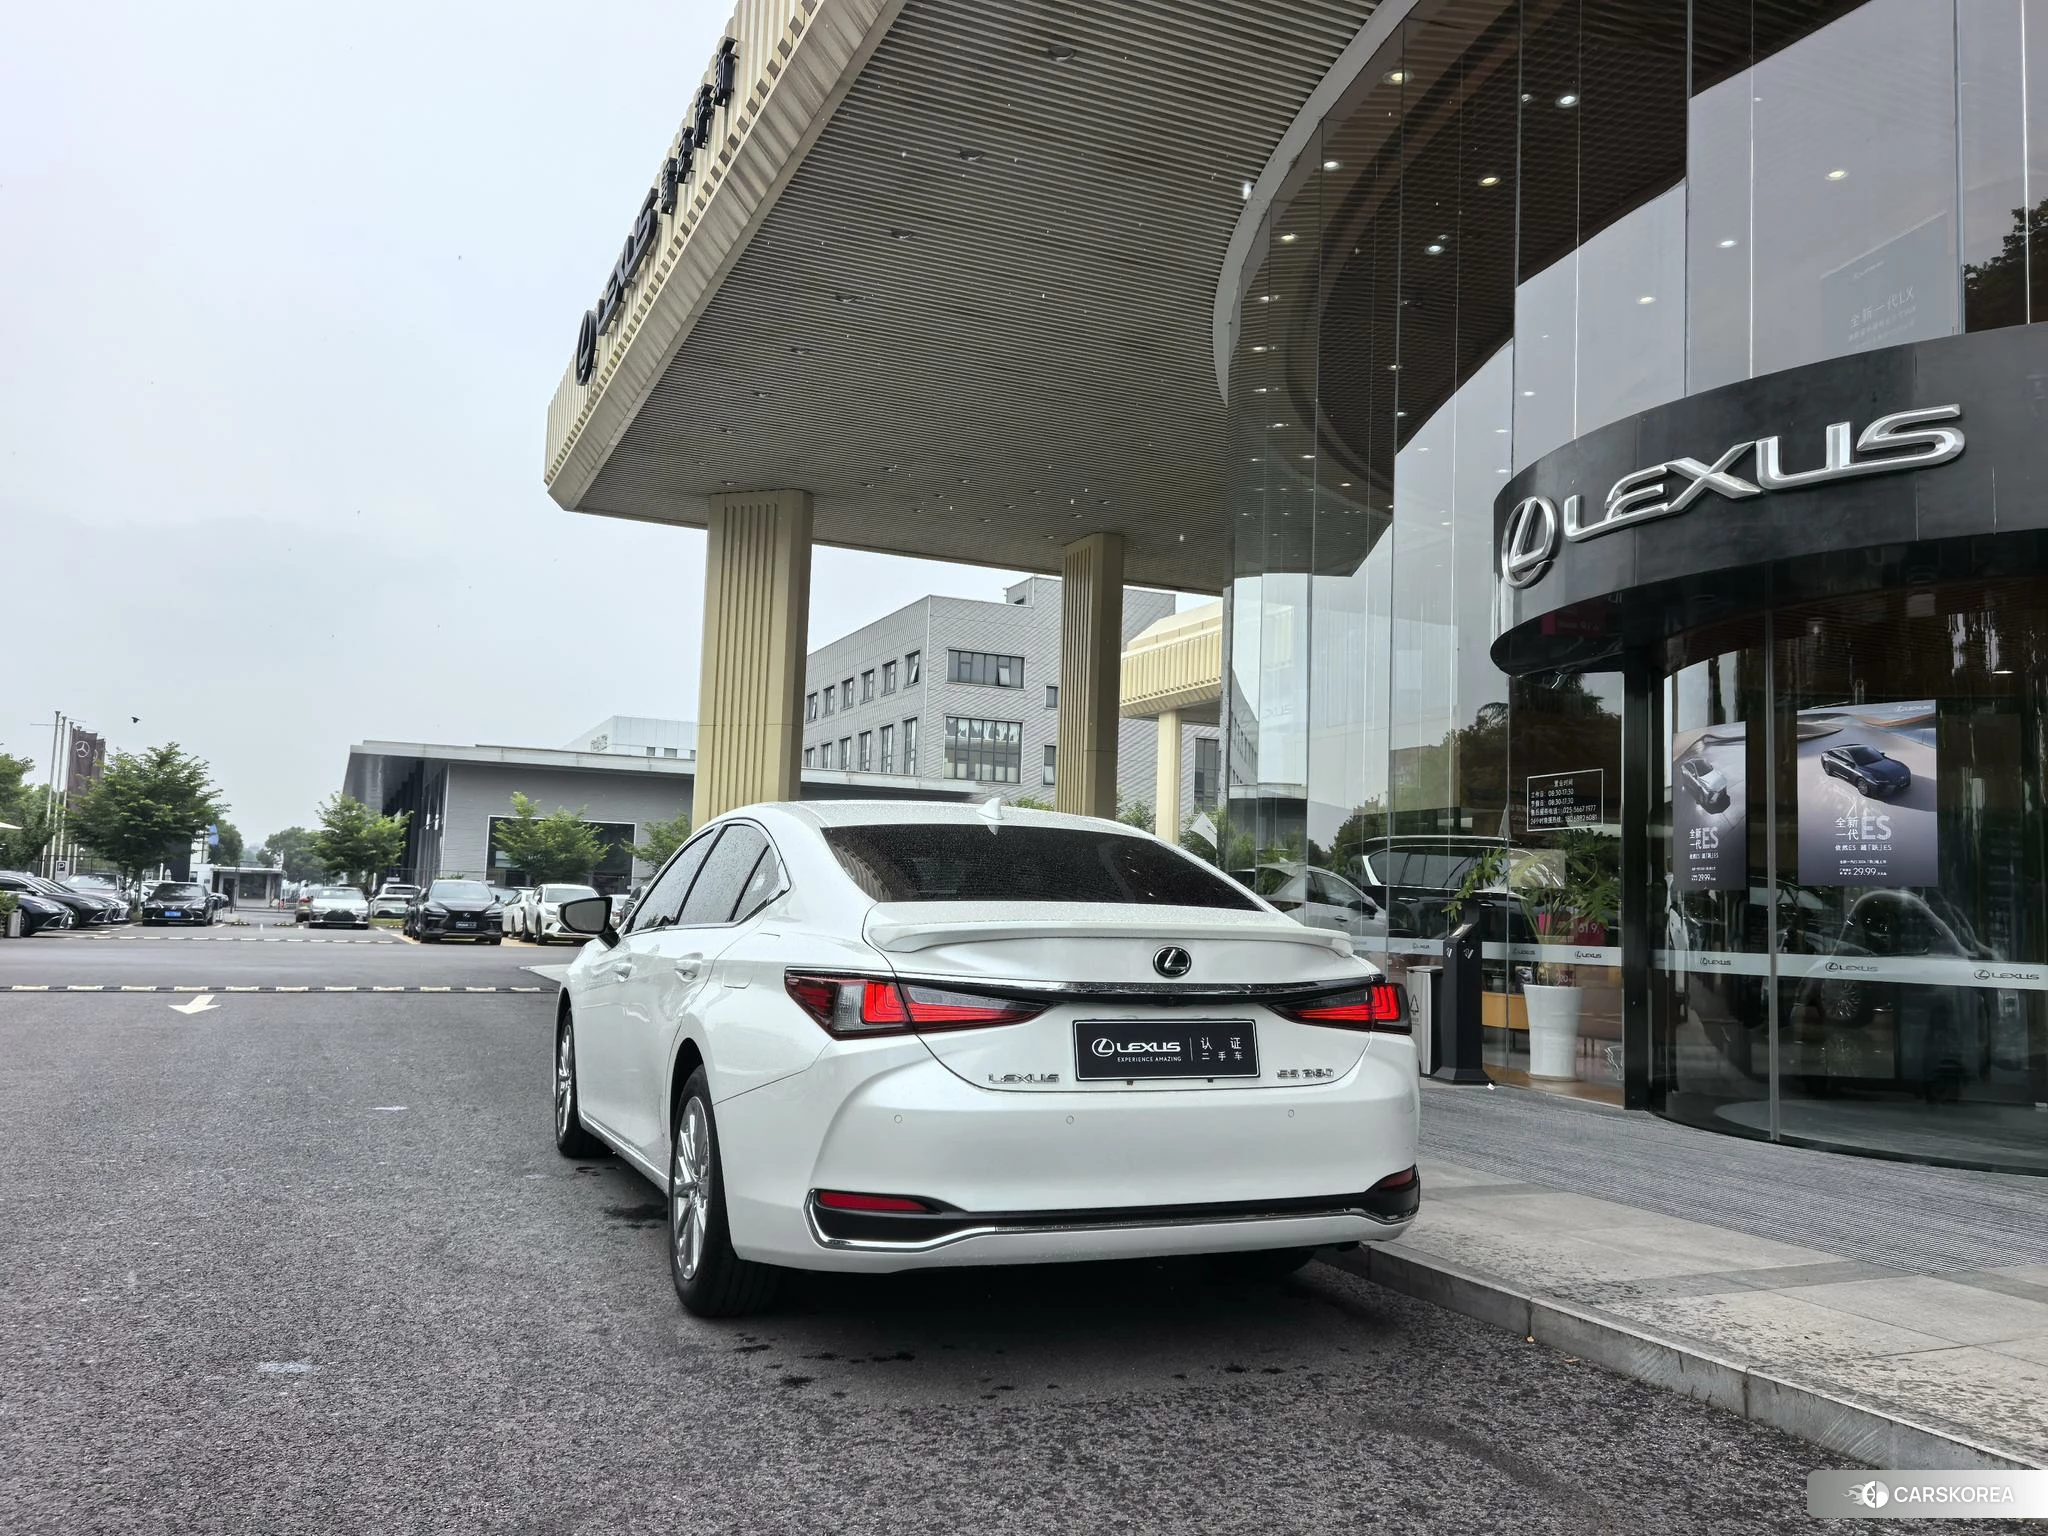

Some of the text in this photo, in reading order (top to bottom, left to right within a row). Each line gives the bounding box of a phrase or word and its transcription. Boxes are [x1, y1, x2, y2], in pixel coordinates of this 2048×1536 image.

[1563, 403, 1966, 543] LEXUS
[1835, 816, 1859, 828] 全新
[1861, 815, 1892, 840] ES
[1702, 826, 1719, 849] ES
[1835, 829, 1859, 841] 一代
[1992, 972, 2040, 980] LEXUS
[1116, 1042, 1181, 1053] LEXUS
[1200, 1036, 1242, 1050] 认证
[1201, 1051, 1243, 1061] 二手车
[988, 1073, 1060, 1084] LEXUS
[1277, 1068, 1300, 1079] ES
